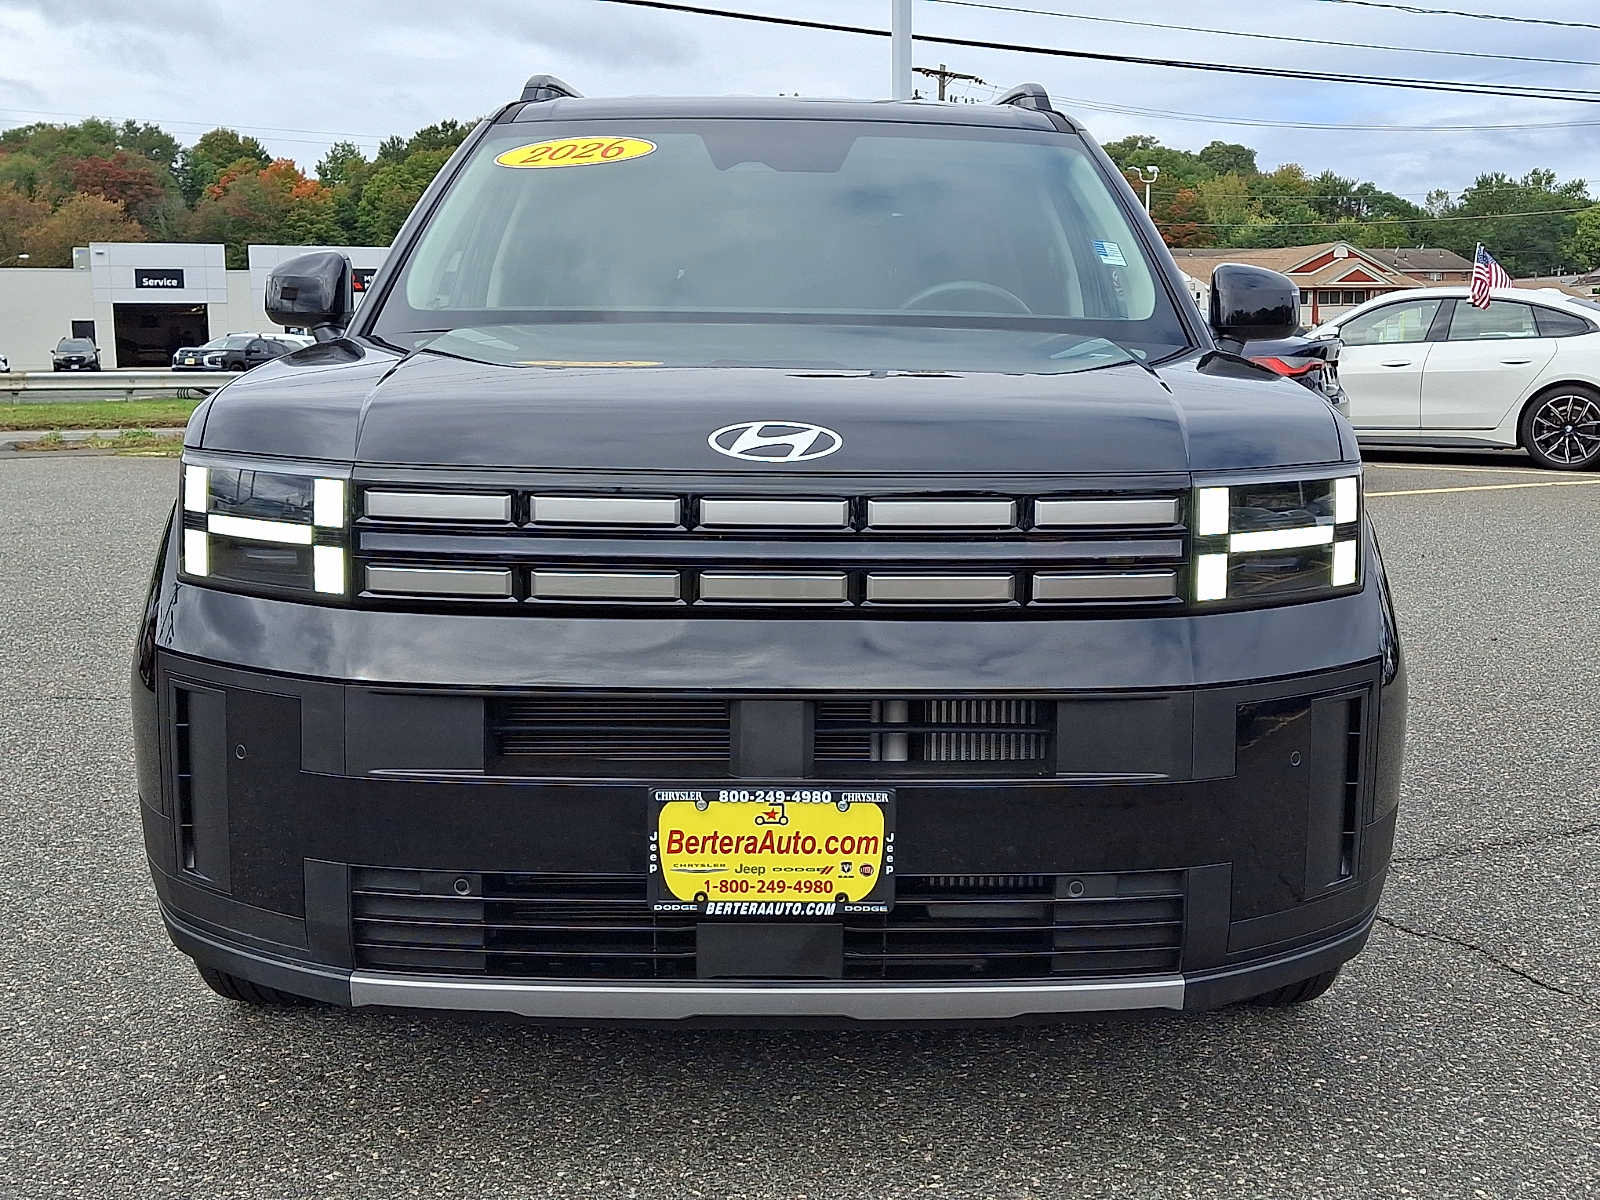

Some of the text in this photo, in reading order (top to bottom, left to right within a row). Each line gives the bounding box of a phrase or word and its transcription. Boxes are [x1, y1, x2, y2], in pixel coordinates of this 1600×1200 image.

[520, 139, 628, 163] 2026
[142, 277, 178, 287] Service
[655, 791, 701, 801] CHRYSLER
[841, 792, 889, 802] CHRYSLER
[667, 829, 879, 855] BerteraAuto.com
[649, 832, 658, 874] Jeep
[885, 832, 895, 875] Jeep
[734, 863, 766, 876] Jeep
[704, 879, 834, 894] 1-800-249-4980
[705, 902, 836, 916] BERTERAAUTO.COM
